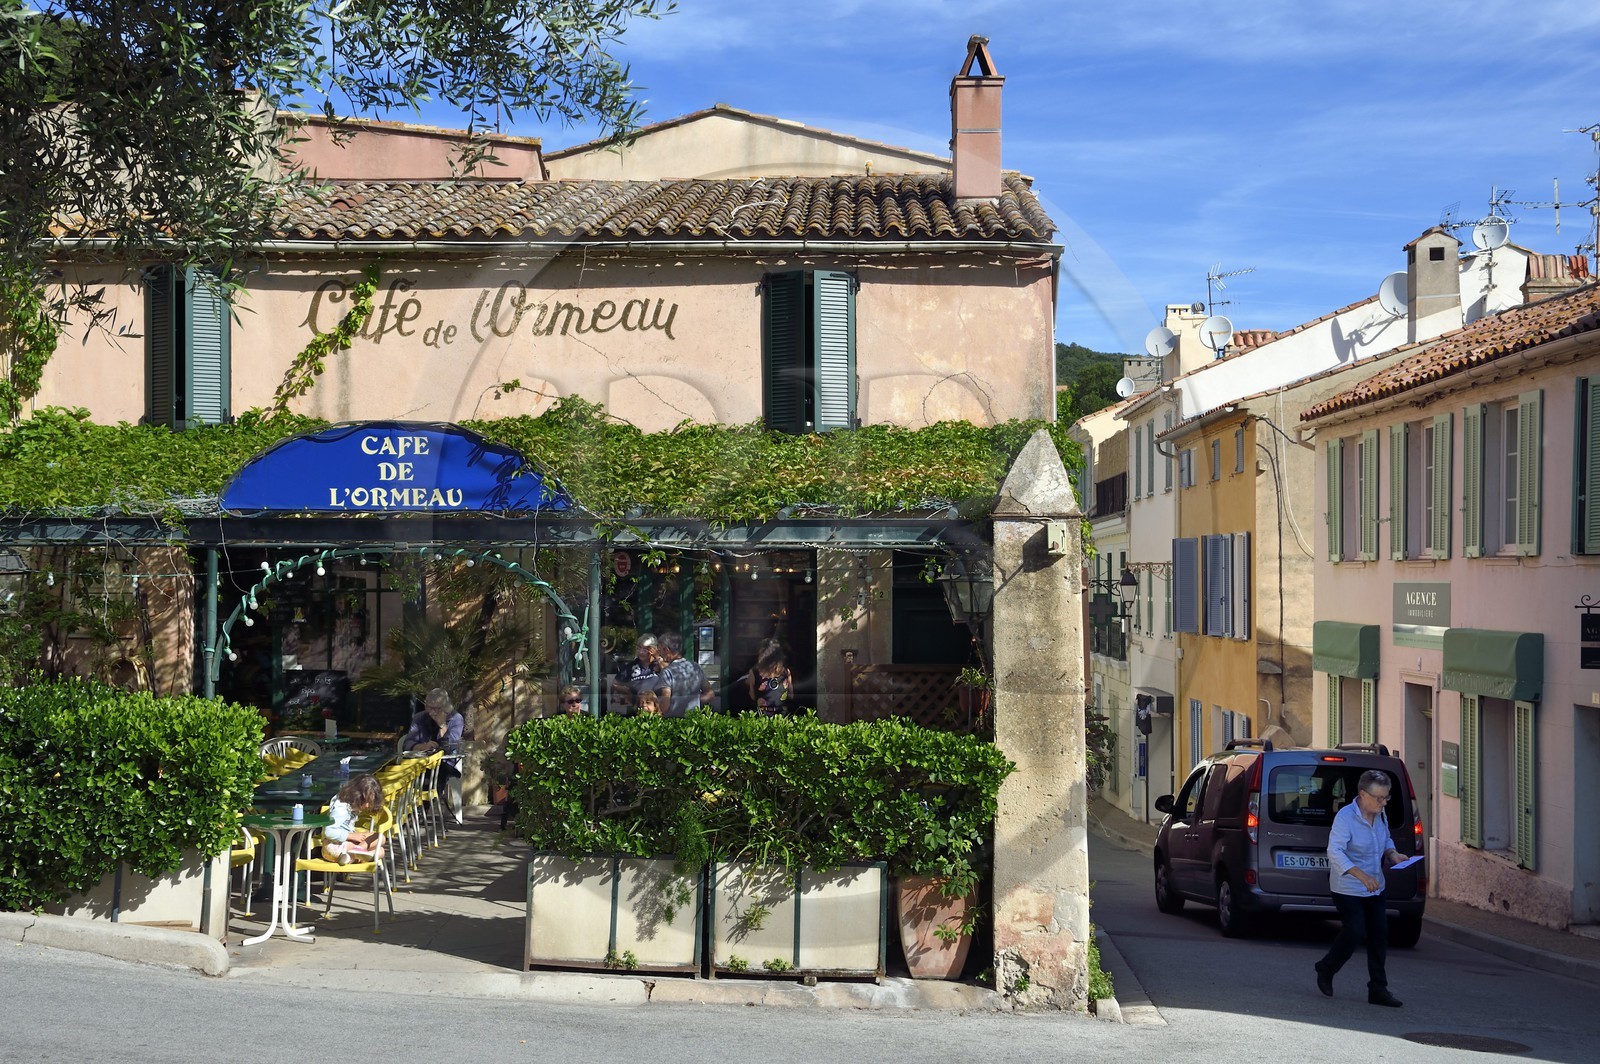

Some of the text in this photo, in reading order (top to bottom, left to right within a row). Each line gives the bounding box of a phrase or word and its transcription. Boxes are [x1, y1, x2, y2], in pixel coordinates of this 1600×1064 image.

[422, 319, 457, 348] de
[361, 435, 429, 458] CAFE
[377, 462, 414, 480] DE
[329, 487, 463, 506] L'ORMEAU
[1405, 591, 1437, 606] AGENCE
